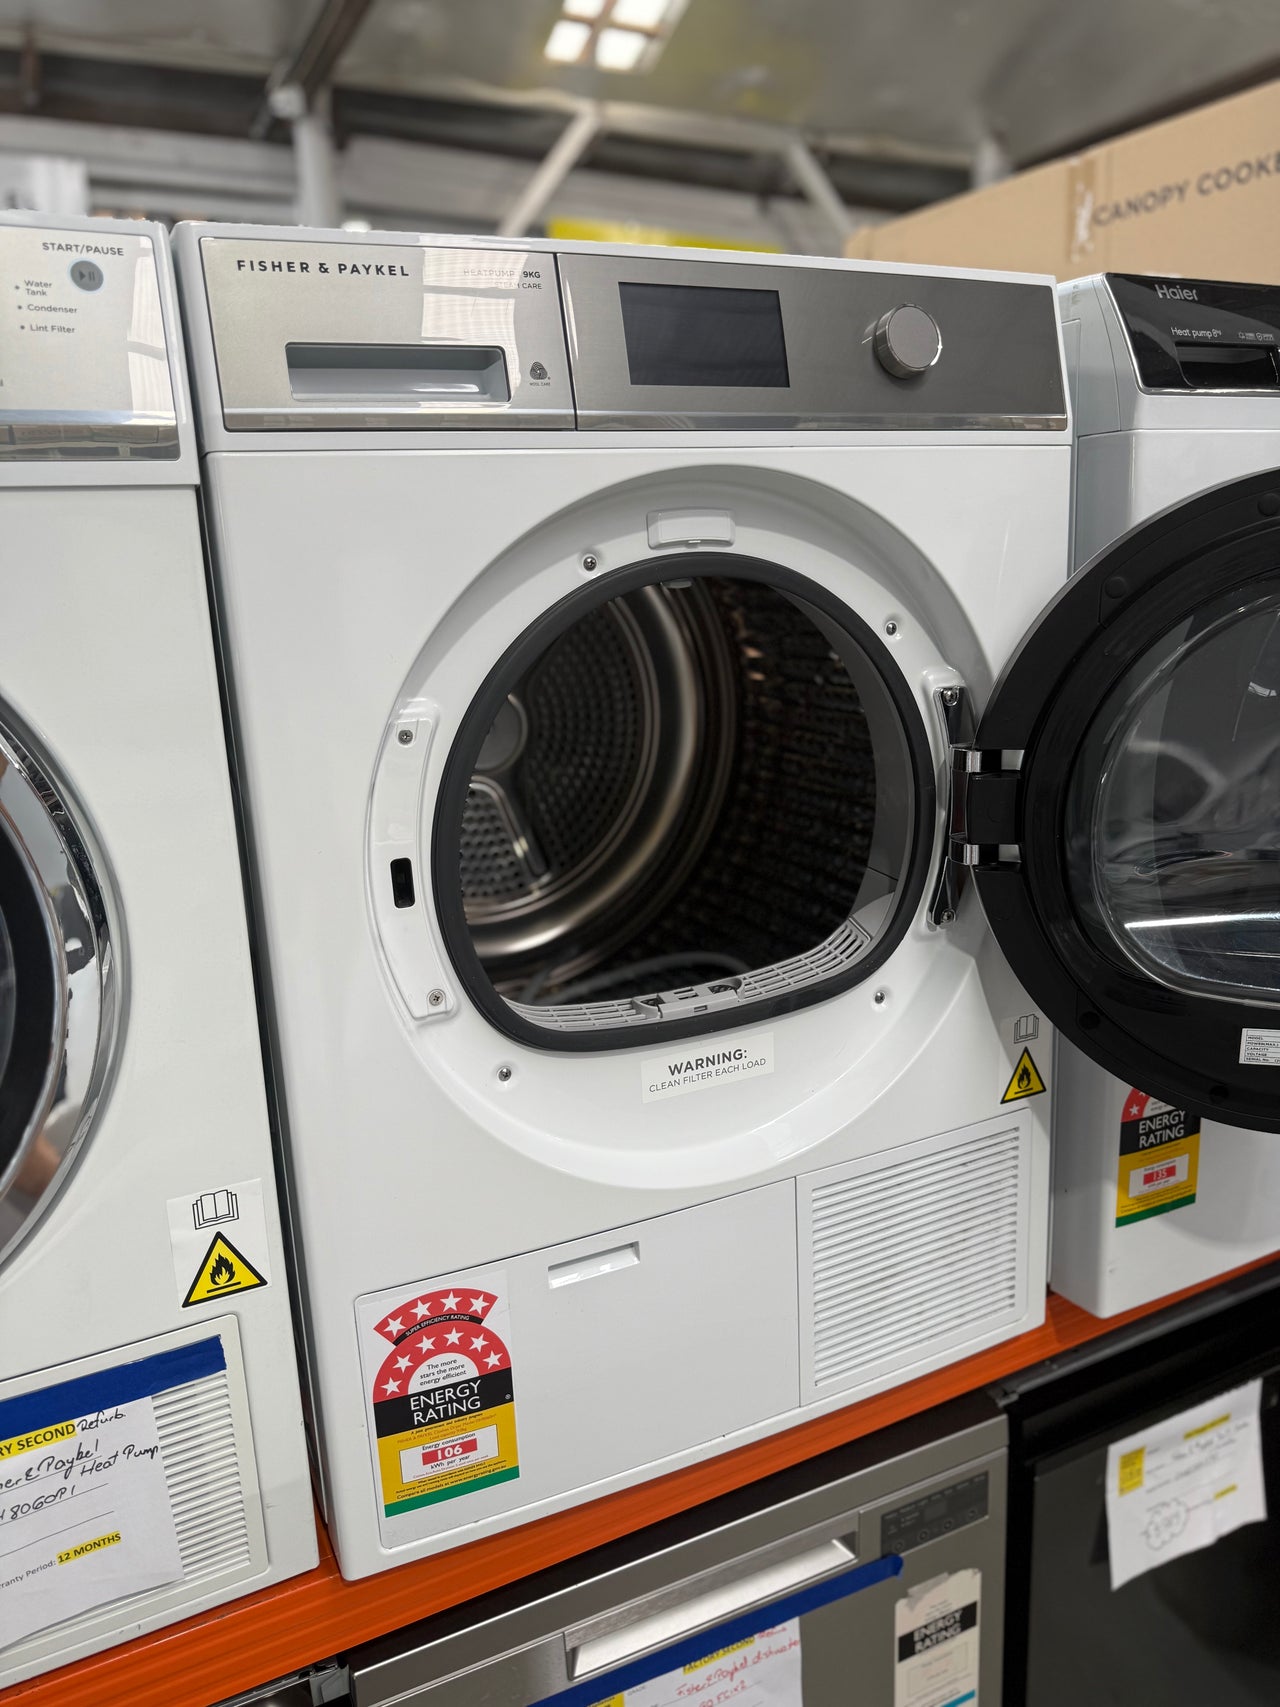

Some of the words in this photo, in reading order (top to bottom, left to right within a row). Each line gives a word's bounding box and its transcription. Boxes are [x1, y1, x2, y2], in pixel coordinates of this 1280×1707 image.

[1093, 180, 1189, 226] CANOPY
[42, 242, 124, 256] START/PAUSE
[237, 260, 309, 273] FISHER
[318, 262, 330, 274] &
[338, 263, 410, 277] PAYKEL
[464, 269, 515, 277] HEATPUMP
[523, 271, 541, 279] 9KG
[24, 280, 52, 289] Water
[1155, 284, 1198, 301] Haier
[27, 303, 77, 314] Condenser
[30, 324, 48, 332] Lint
[51, 325, 75, 334] Filter
[1170, 327, 1191, 337] Heat
[1192, 330, 1212, 340] pump
[668, 1048, 747, 1076] WARNING:
[649, 1078, 681, 1093] CLEAN
[683, 1070, 713, 1085] FILTER
[715, 1064, 740, 1077] EACH
[742, 1058, 766, 1070] LOAD
[1139, 1110, 1186, 1134] ENERGY
[1139, 1124, 1184, 1149] RATING
[1153, 1168, 1167, 1180] 135
[405, 1325, 421, 1336] SUPER
[421, 1315, 450, 1327] EFFICIENCY
[427, 1363, 440, 1371] The
[440, 1359, 457, 1367] more
[448, 1364, 465, 1372] more
[420, 1376, 441, 1386] energy
[442, 1370, 467, 1380] efficient
[410, 1380, 482, 1411] ENERGY
[412, 1395, 481, 1426] RATING
[17, 1424, 76, 1451] SECOND
[422, 1442, 440, 1451] Energy
[441, 1432, 476, 1446] consumption
[81, 1450, 119, 1477] Heat
[122, 1444, 159, 1460] Pump
[430, 1461, 445, 1470] kWh
[447, 1458, 457, 1466] per
[458, 1454, 471, 1463] year
[437, 1445, 463, 1460] 106
[25, 1559, 56, 1578] Period:
[58, 1552, 71, 1564] 12
[73, 1533, 122, 1557] MONTHS
[914, 1610, 963, 1642] ENERGY
[914, 1623, 962, 1654] RATING
[683, 1649, 721, 1673] FACTORY
